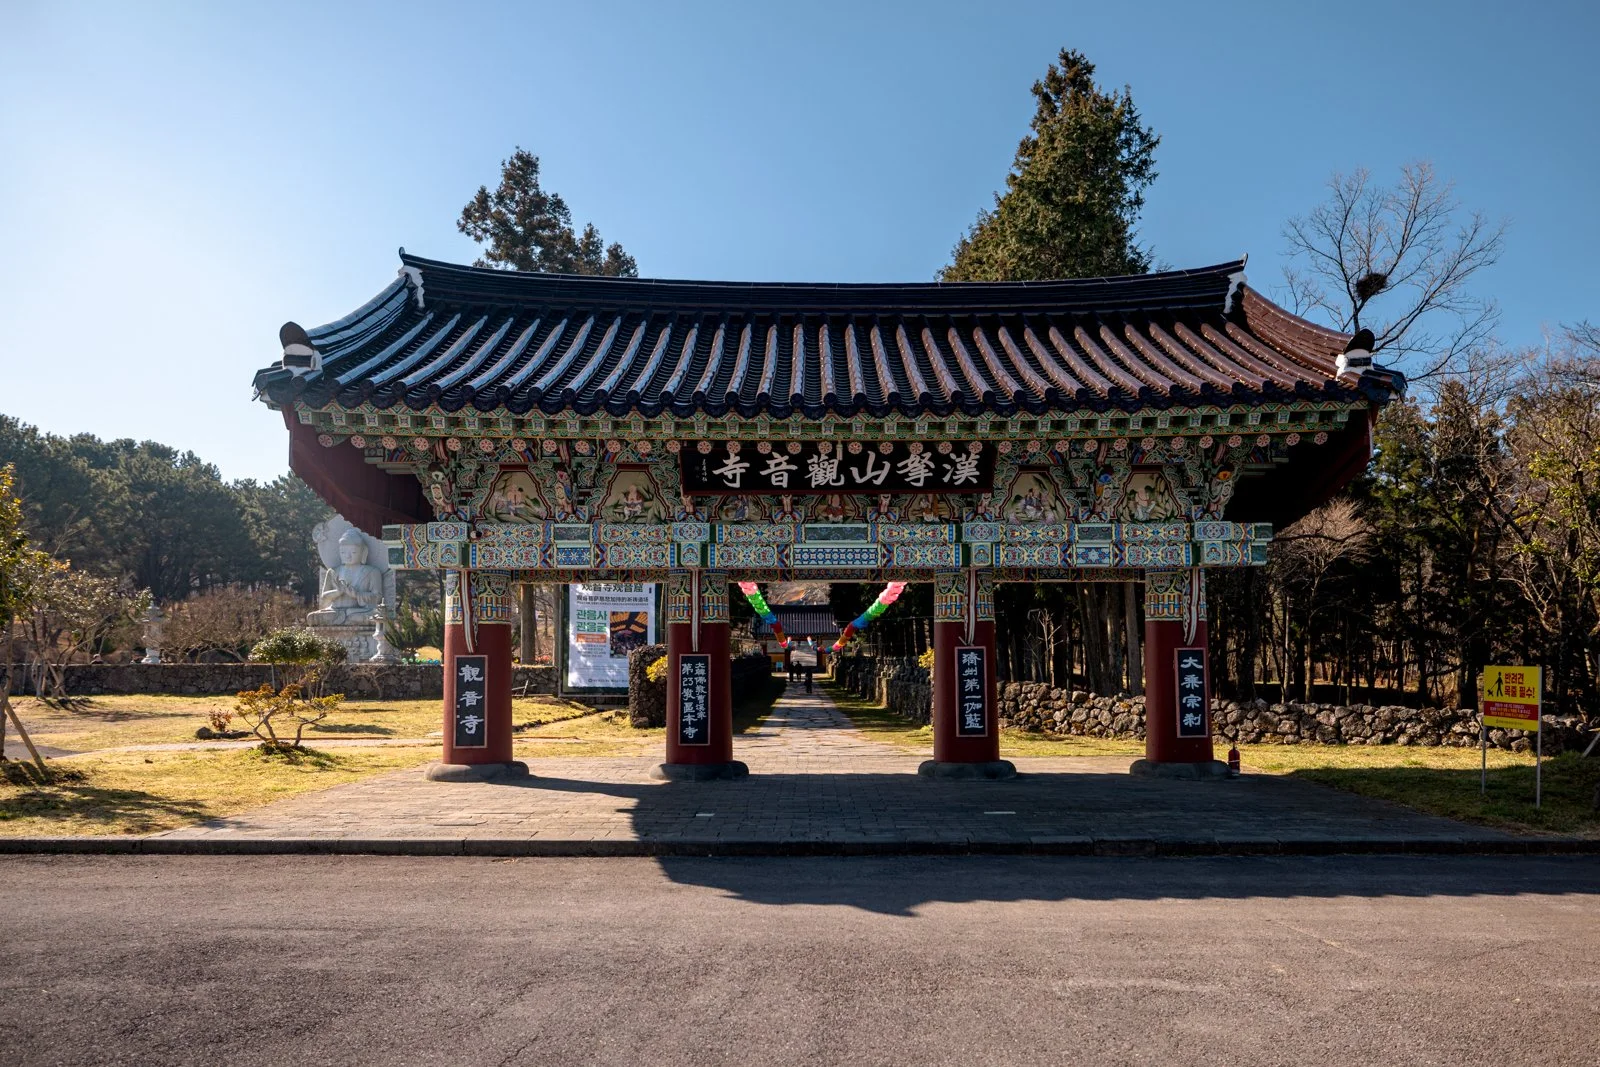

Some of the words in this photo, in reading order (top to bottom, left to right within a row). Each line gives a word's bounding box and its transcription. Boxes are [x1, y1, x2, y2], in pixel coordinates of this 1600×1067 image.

[576, 609, 608, 621] 관음사
[1504, 673, 1525, 684] 반려견
[1504, 686, 1517, 697] 목줄
[1519, 686, 1535, 699] 필수!
[458, 664, 484, 735] 觀音寺
